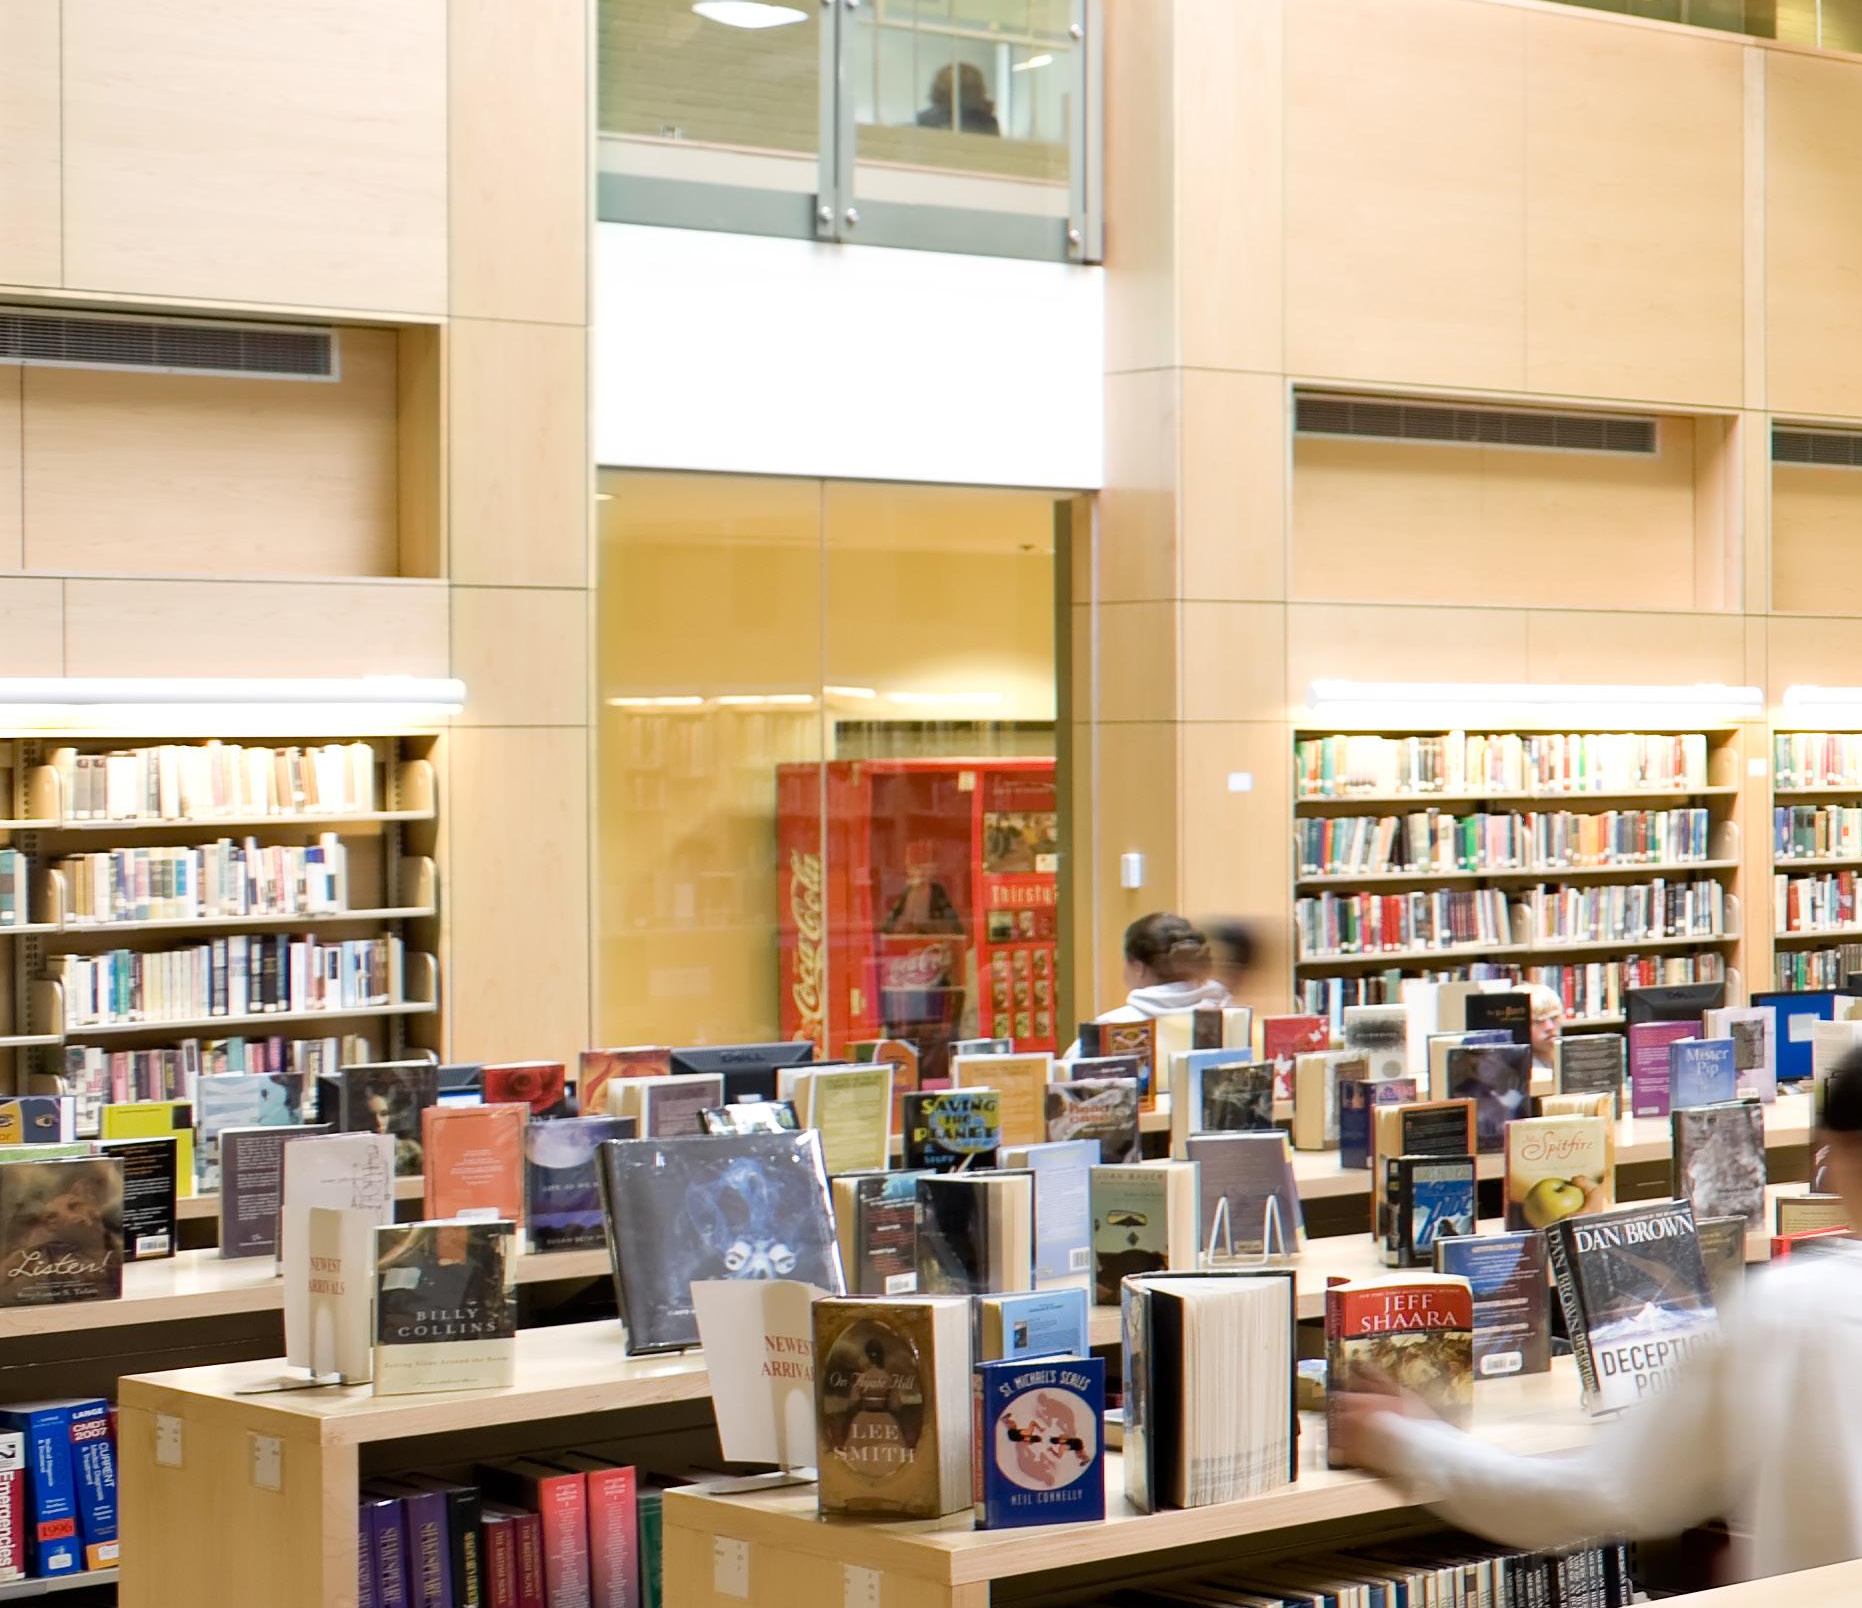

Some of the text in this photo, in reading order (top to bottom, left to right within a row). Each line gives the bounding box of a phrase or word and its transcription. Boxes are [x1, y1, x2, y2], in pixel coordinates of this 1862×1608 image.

[1686, 1047, 1729, 1063] Mister
[1697, 1061, 1719, 1076] Pip
[921, 1099, 995, 1116] SAVING
[913, 1126, 998, 1142] PLANET
[1521, 1130, 1594, 1162] Spitfire
[1574, 1226, 1622, 1254] DAN
[1626, 1212, 1696, 1245] BROWN
[1548, 1228, 1567, 1268] DAN
[8, 1250, 113, 1278] Listen!
[1385, 1293, 1433, 1315] JEFF
[1557, 1272, 1581, 1333] BROWN
[416, 1307, 480, 1323] BILLY
[1361, 1310, 1458, 1333] SHAARA
[398, 1320, 498, 1338] COLLINS
[71, 1406, 104, 1420] LANGE
[74, 1426, 109, 1442] 2007
[851, 1423, 899, 1440] LEE
[833, 1445, 917, 1464] SMITH
[99, 1442, 115, 1488] CURRENT
[1010, 1489, 1084, 1507] NEIL CONNELLY
